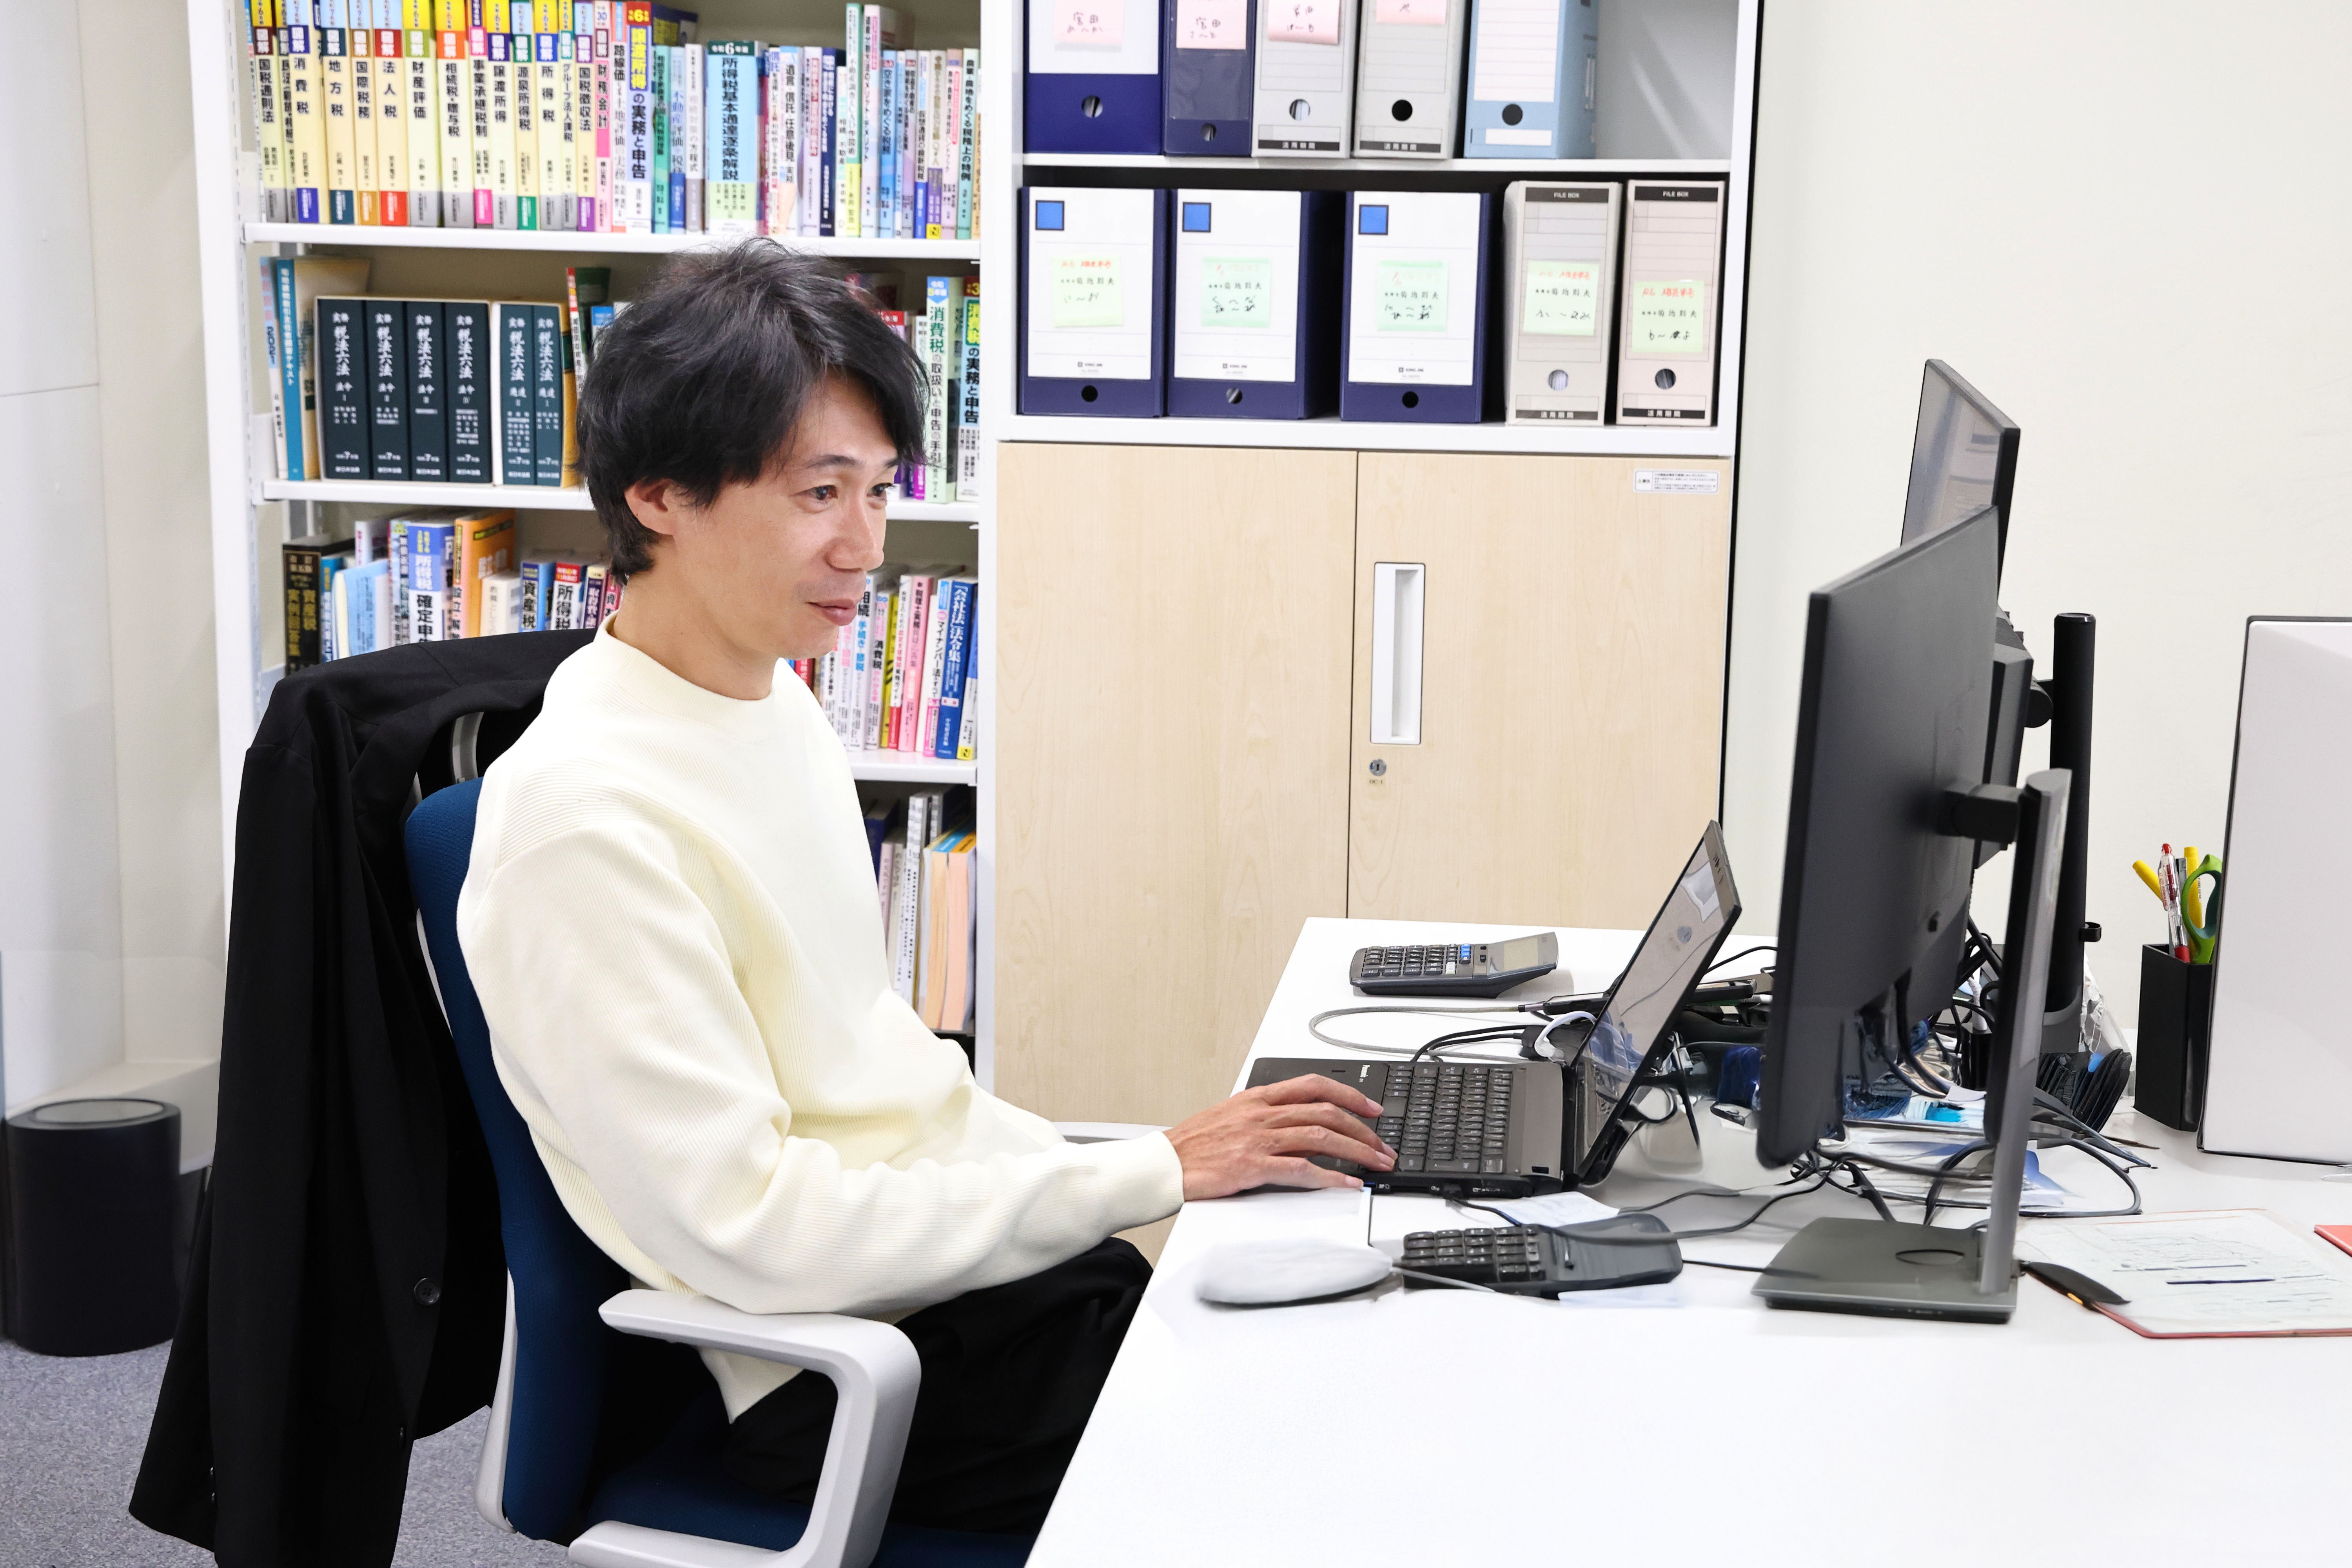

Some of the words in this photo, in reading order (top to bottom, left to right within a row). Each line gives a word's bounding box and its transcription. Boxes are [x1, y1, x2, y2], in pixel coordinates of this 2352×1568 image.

[597, 12, 607, 21] 30
[259, 59, 274, 123] 国税通則法
[294, 57, 309, 115] 消費税
[329, 60, 344, 117] 地方税
[356, 61, 370, 118] 国際税務
[383, 61, 397, 118] 法人税
[412, 62, 426, 119] 財産評価
[446, 63, 460, 137] 相続税・贈与税
[473, 60, 488, 137] 事業承継税制
[494, 65, 506, 123] 譲渡所得
[517, 66, 532, 131] 源泉所得税
[542, 66, 555, 122] 所得税
[563, 64, 573, 142] グループ法人課税
[579, 67, 592, 131] 国税徴収法
[598, 64, 608, 129] 財務会計
[334, 325, 350, 376] 税法六法
[377, 326, 393, 377] 税法六法
[417, 327, 433, 378] 税法六法
[457, 328, 474, 379] 税法六法
[510, 330, 525, 381] 税法六法
[539, 331, 554, 382] 税法六法
[555, 584, 573, 630] 所得税
